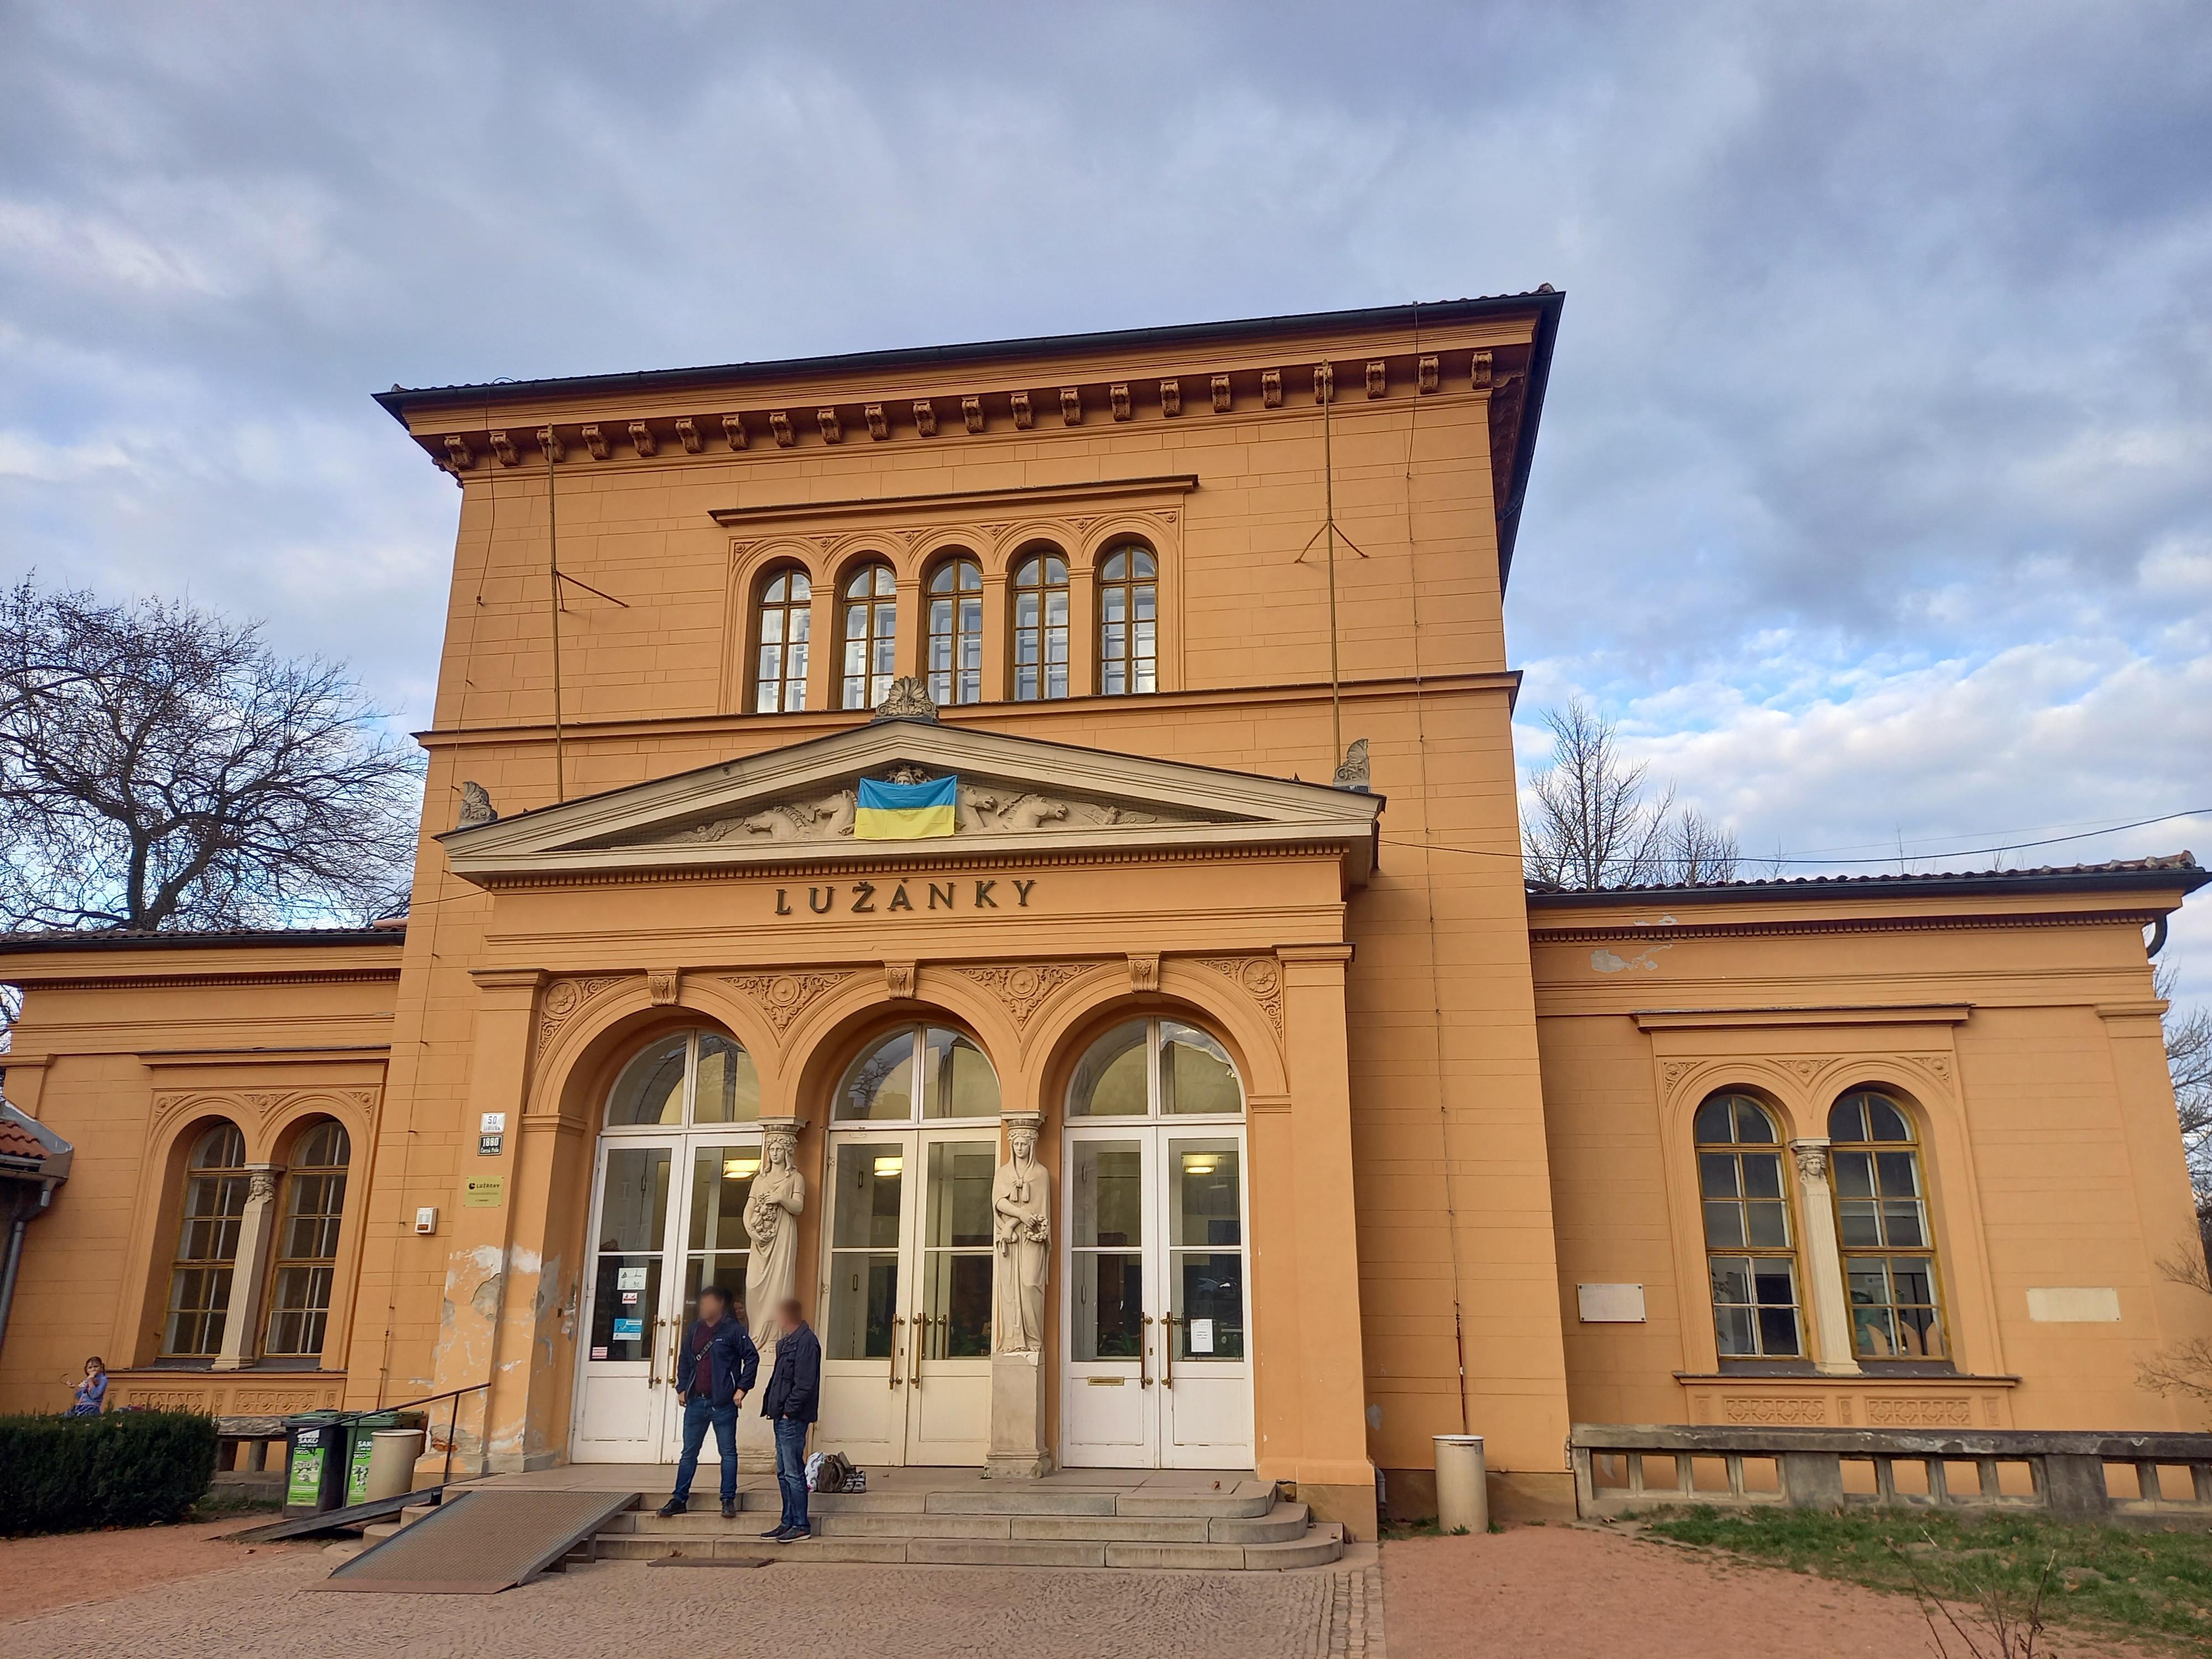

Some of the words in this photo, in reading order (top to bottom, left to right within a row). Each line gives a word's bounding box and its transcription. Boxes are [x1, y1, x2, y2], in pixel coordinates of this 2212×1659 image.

[775, 878, 1036, 915] LUŽÁNKY
[488, 1116, 497, 1124] 50
[483, 1137, 499, 1147] 1880
